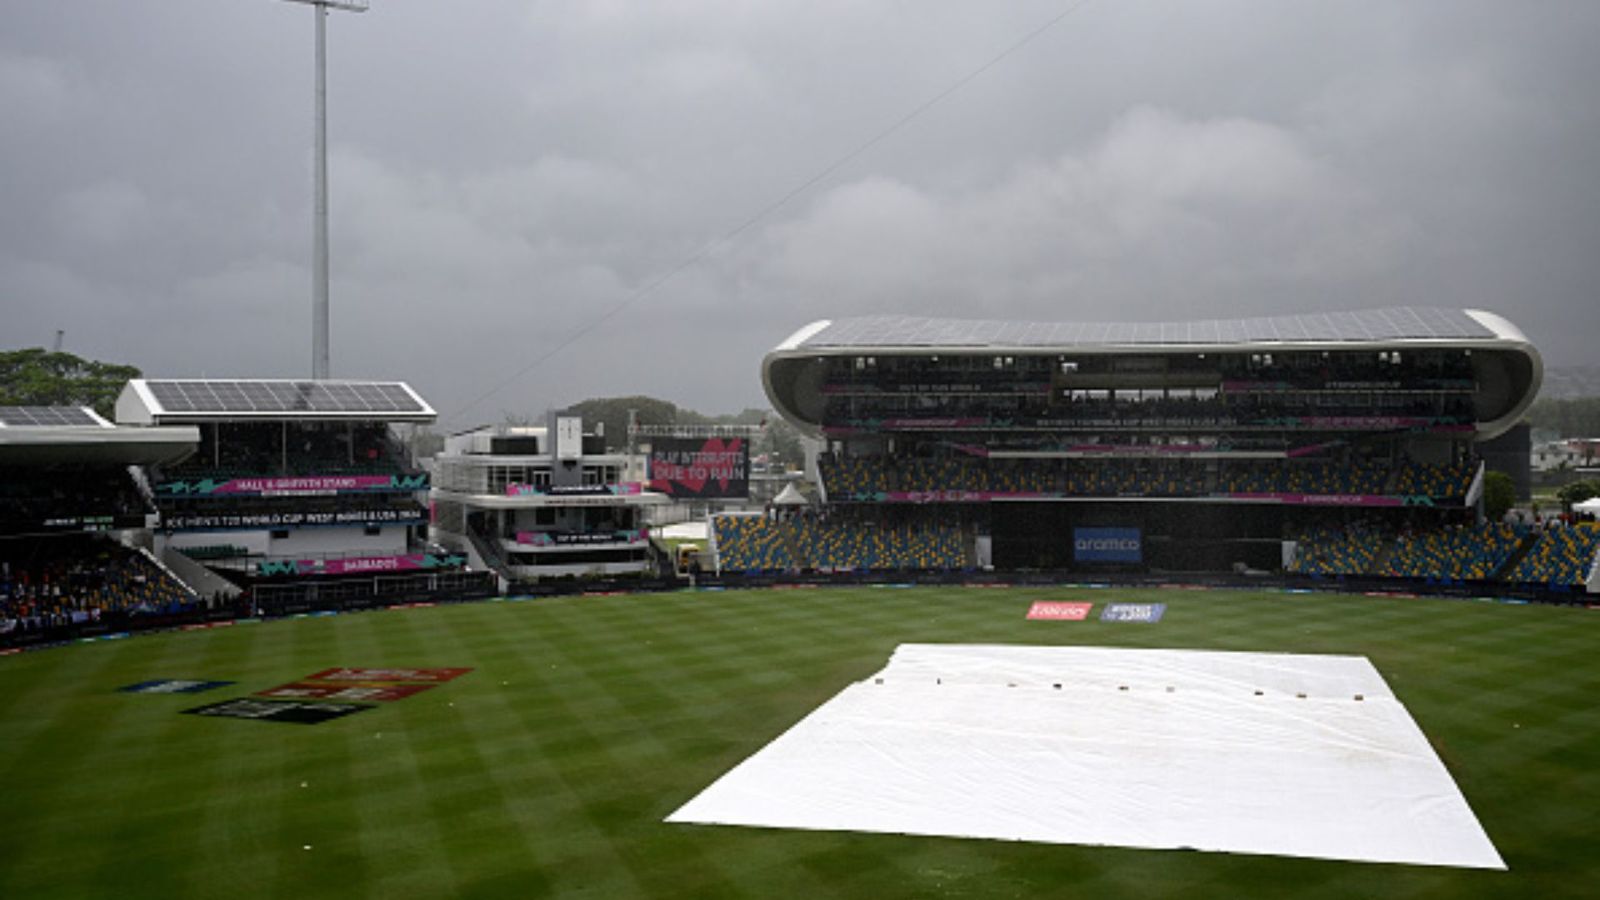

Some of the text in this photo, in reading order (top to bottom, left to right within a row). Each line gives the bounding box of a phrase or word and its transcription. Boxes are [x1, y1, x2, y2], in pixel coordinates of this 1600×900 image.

[655, 452, 680, 464] PLAY
[655, 467, 745, 480] DUE TO RAIN
[236, 480, 263, 490] HALL
[322, 478, 357, 488] STAND
[242, 514, 280, 525] WORLD
[282, 514, 303, 524] CUP
[306, 513, 335, 523] WEST
[1075, 538, 1140, 550] aramco
[344, 557, 398, 571] BARBADOS
